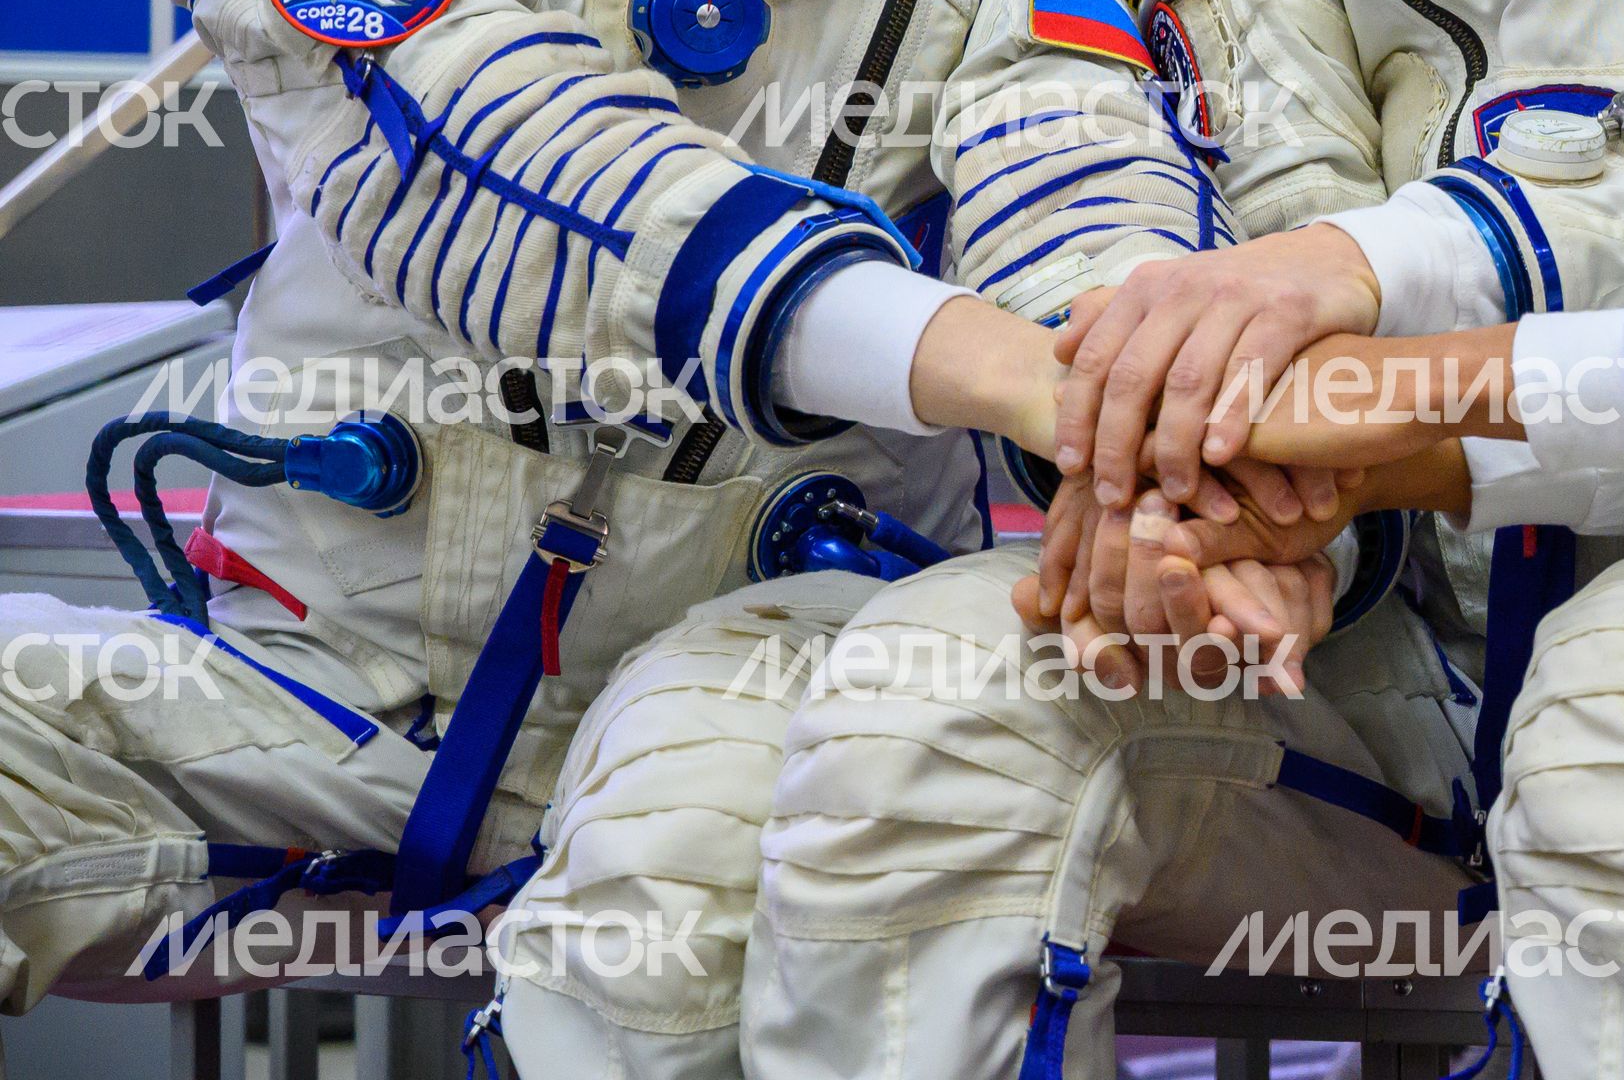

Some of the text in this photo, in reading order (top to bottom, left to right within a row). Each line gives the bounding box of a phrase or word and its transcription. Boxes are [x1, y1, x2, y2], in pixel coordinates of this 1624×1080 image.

[297, 4, 346, 19] СОЮЗ
[320, 6, 385, 39] МС 28
